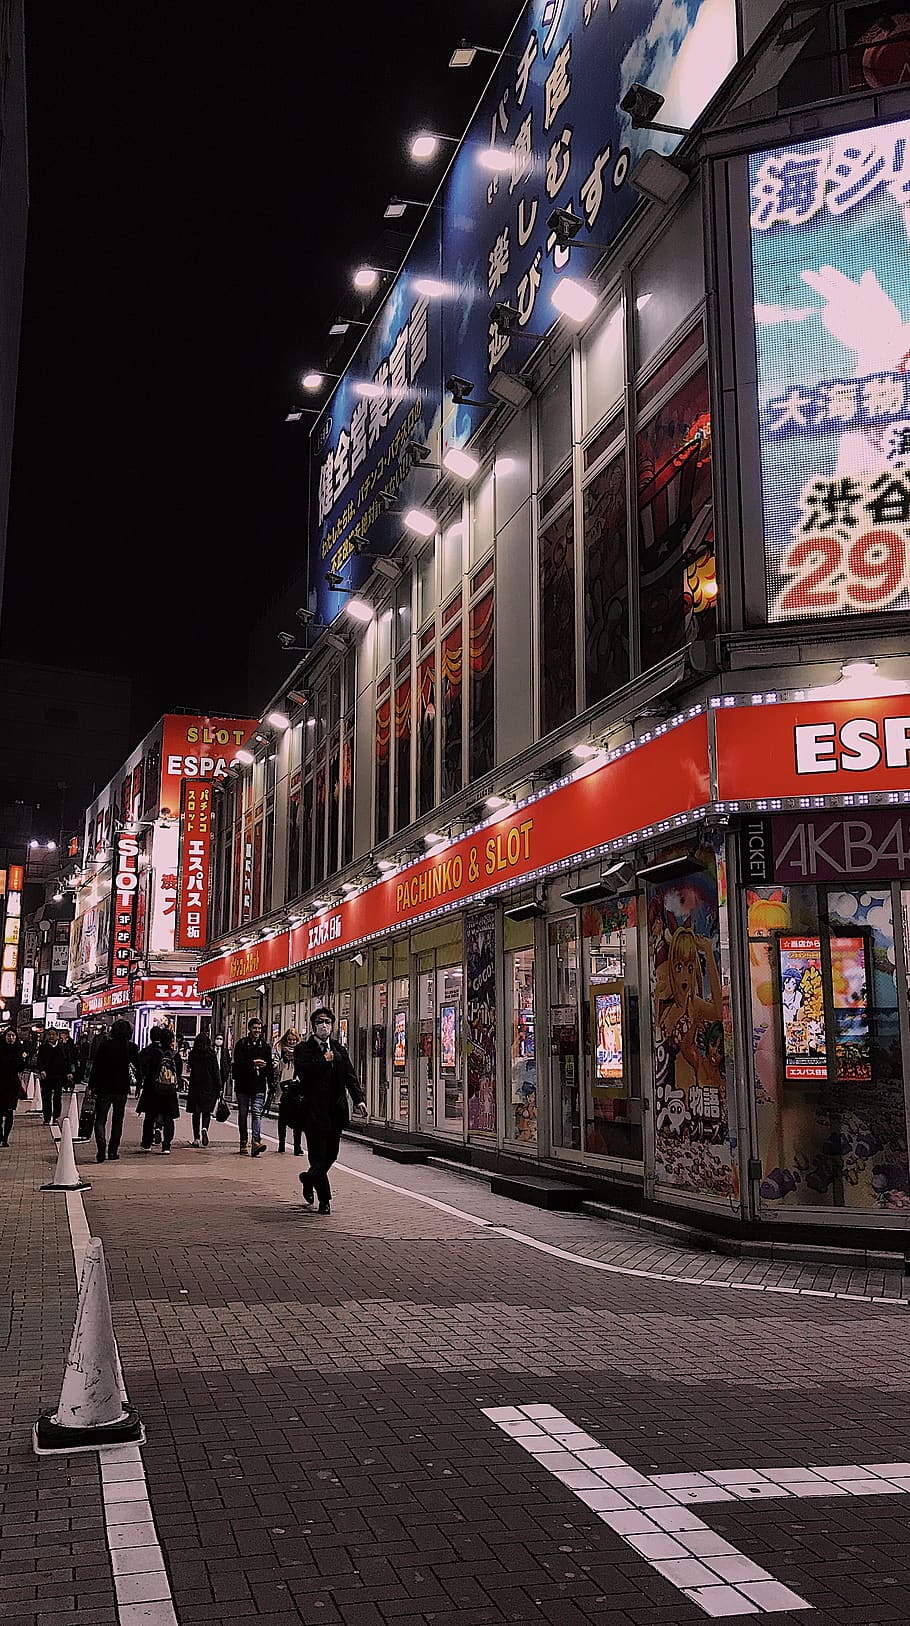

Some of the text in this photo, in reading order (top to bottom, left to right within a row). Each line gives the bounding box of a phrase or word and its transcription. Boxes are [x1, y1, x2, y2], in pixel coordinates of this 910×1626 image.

[488, 127, 571, 297] 楽しむ
[781, 530, 905, 610] 29
[187, 727, 245, 745] SLOT
[187, 790, 196, 832] スロット
[200, 789, 209, 833] パチンコ
[115, 839, 139, 906] SLOT
[396, 820, 533, 912] PACHINKO & SLOT
[748, 821, 766, 879] TICKET
[776, 818, 910, 876] AKB4
[118, 932, 129, 941] 2F
[119, 915, 130, 924] 3F
[117, 949, 129, 958] 1F
